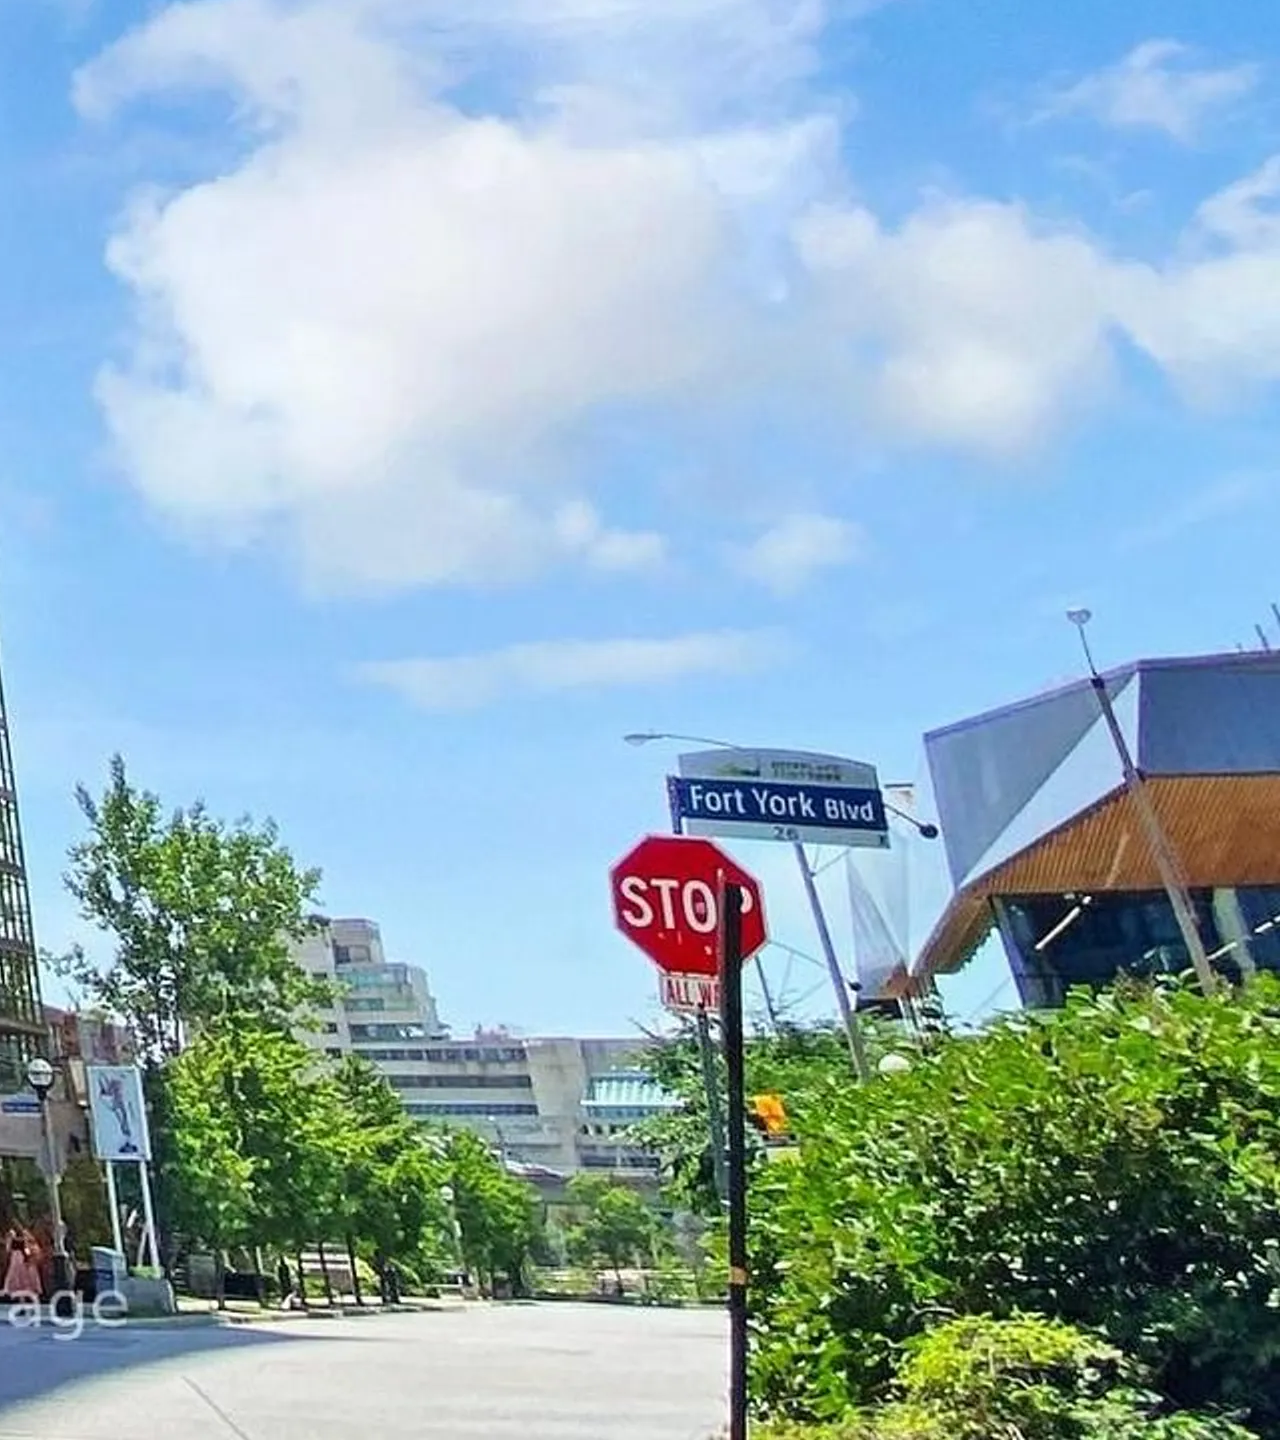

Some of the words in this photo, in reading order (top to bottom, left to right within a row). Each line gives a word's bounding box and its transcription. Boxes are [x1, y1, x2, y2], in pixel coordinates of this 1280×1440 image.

[690, 786, 746, 813] Fort
[752, 788, 816, 817] York
[824, 798, 874, 821] Blvd
